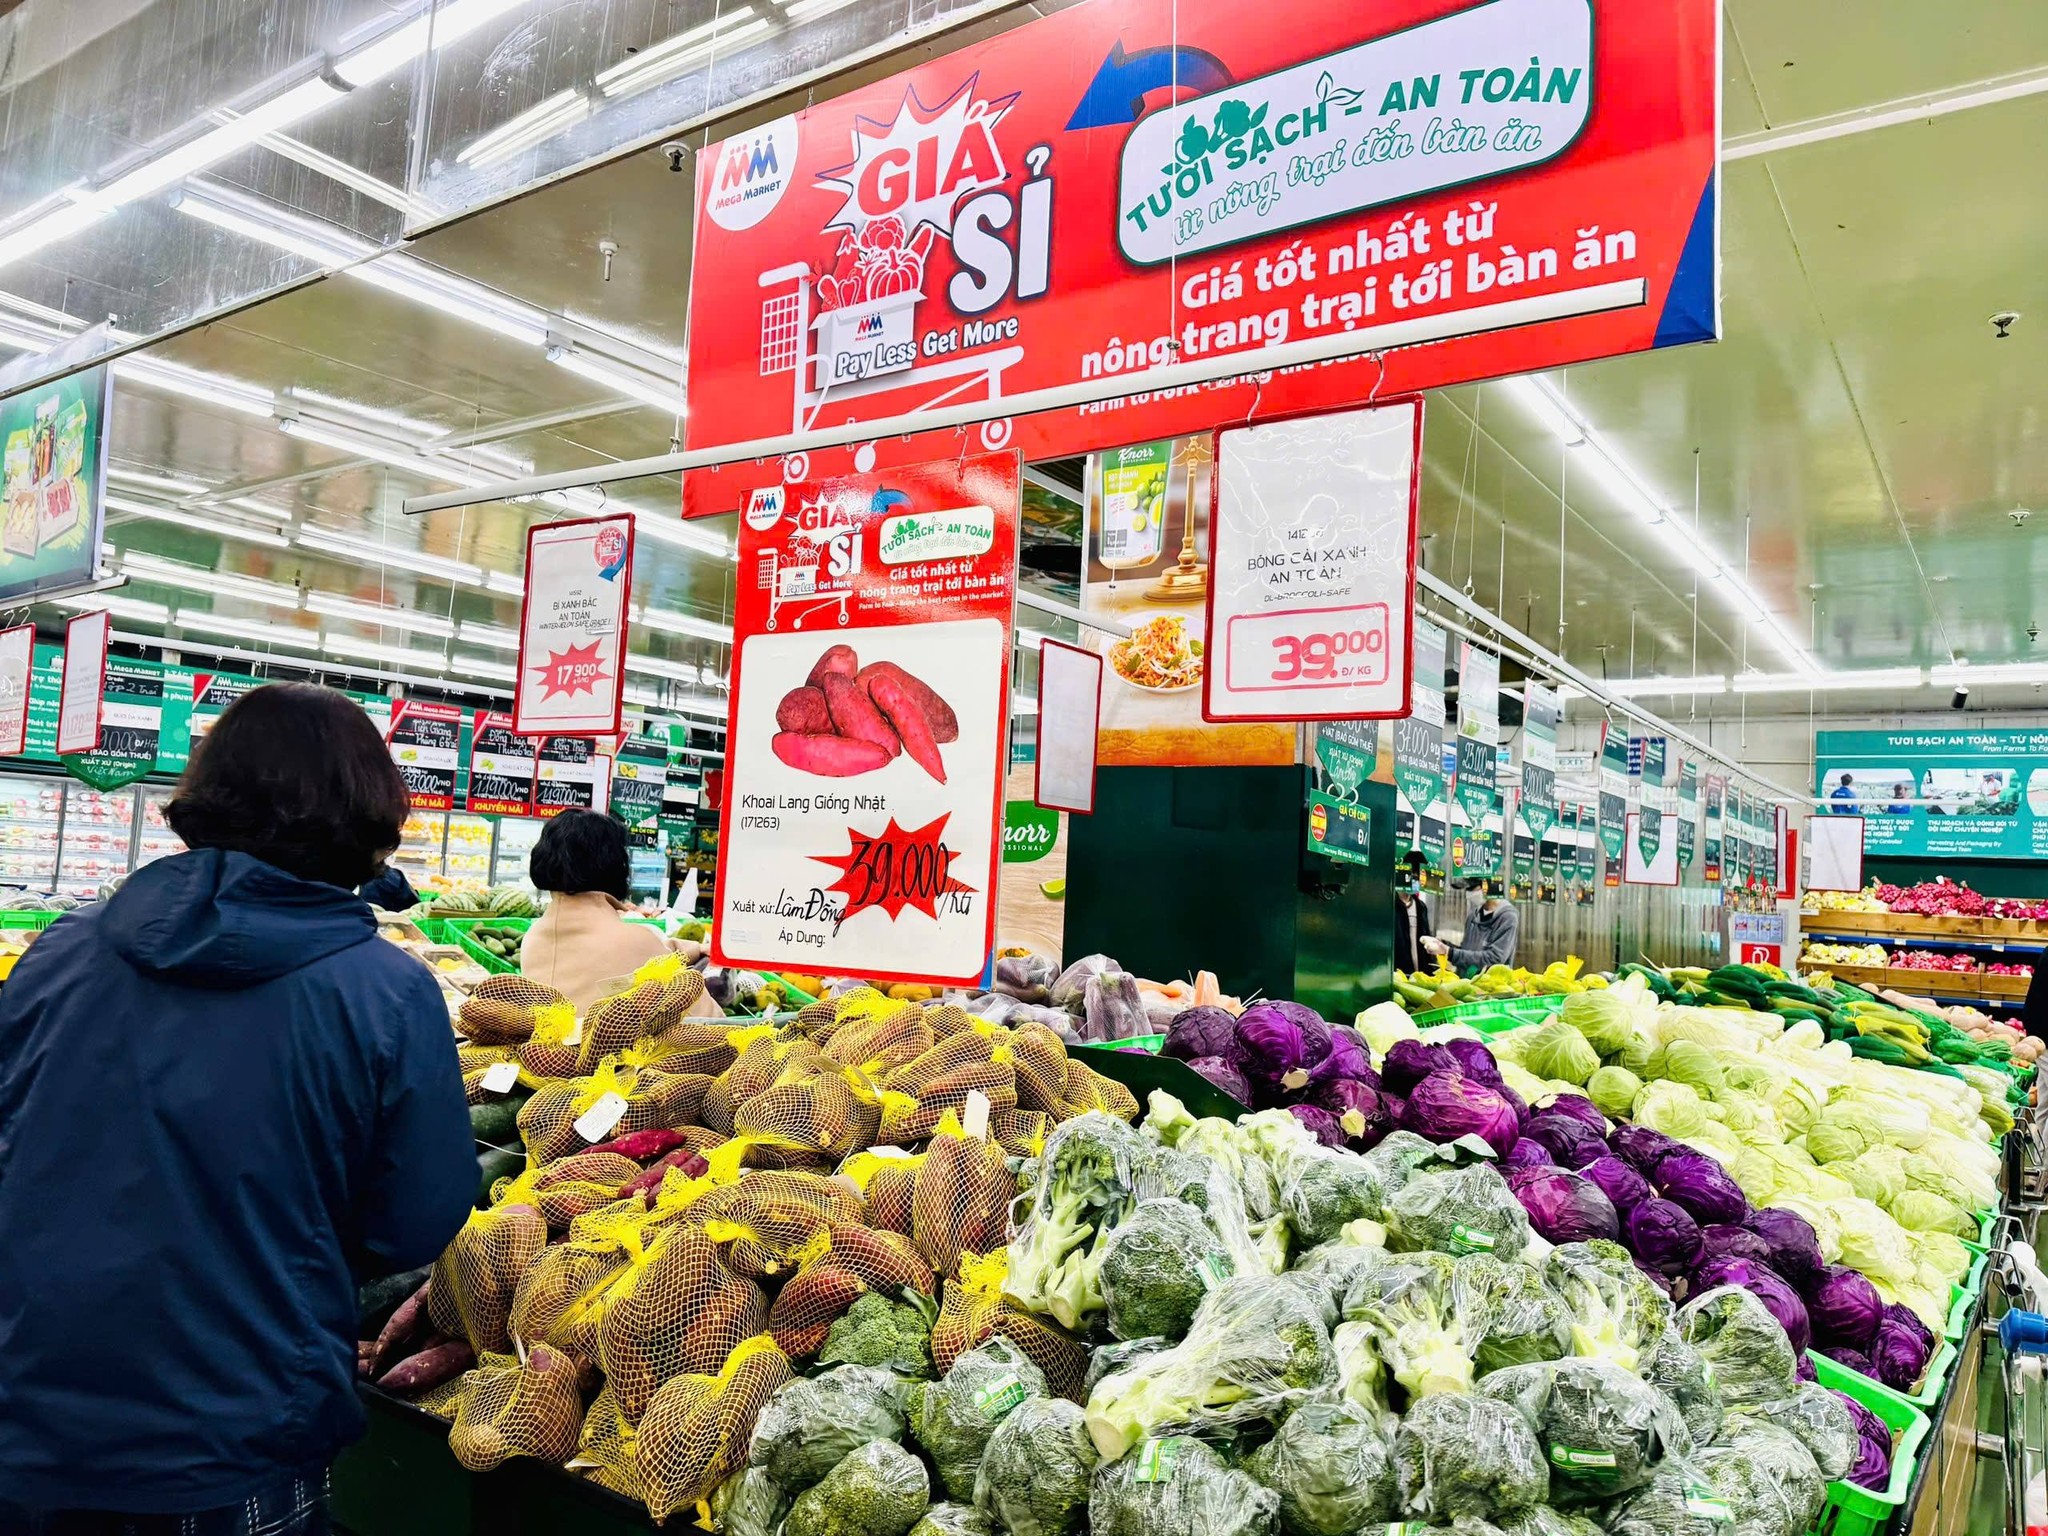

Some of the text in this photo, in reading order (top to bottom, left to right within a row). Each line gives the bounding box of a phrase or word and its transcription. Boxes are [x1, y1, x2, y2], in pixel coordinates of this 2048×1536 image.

[1225, 99, 1327, 171] SẠCH
[1378, 73, 1441, 117] AN
[1457, 55, 1582, 105] TOÀN
[1208, 171, 1281, 225] nông
[1286, 140, 1345, 187] trại
[1352, 117, 1413, 171] đến
[1421, 119, 1487, 156] bàn
[1493, 121, 1543, 153] ăn
[949, 145, 1053, 313] SỈ
[1181, 201, 1500, 310] Giá tốt nhất từ
[1182, 305, 1291, 358] trang
[1302, 285, 1376, 334] trại
[1389, 257, 1453, 309] tới
[1466, 246, 1559, 292] bàn
[1573, 227, 1638, 271] ăn
[836, 316, 1019, 382] Pay Less Get More
[1118, 447, 1155, 462] Knorr
[908, 524, 935, 541] SẠCH
[946, 523, 961, 533] AN
[965, 524, 992, 540] TOÀN
[890, 567, 908, 581] Giá
[910, 563, 928, 579] tốt
[930, 561, 957, 577] nhất
[1269, 571, 1290, 585] AN
[890, 584, 920, 596] trang
[923, 579, 943, 595] trại
[964, 575, 987, 588] bàn
[1357, 665, 1372, 676] KG
[1888, 736, 1914, 746] TƯƠI
[1916, 736, 1946, 747] SẠCH
[1948, 736, 1964, 745] AN
[1967, 734, 1997, 745] TOÀN
[742, 793, 886, 814] Khoai Lang Giống Nhật
[740, 816, 780, 830] (171263)
[1003, 823, 1052, 844] norr
[732, 897, 756, 914] Xuất
[775, 888, 806, 921] Lâm
[778, 925, 826, 946] Áp Dụng:
